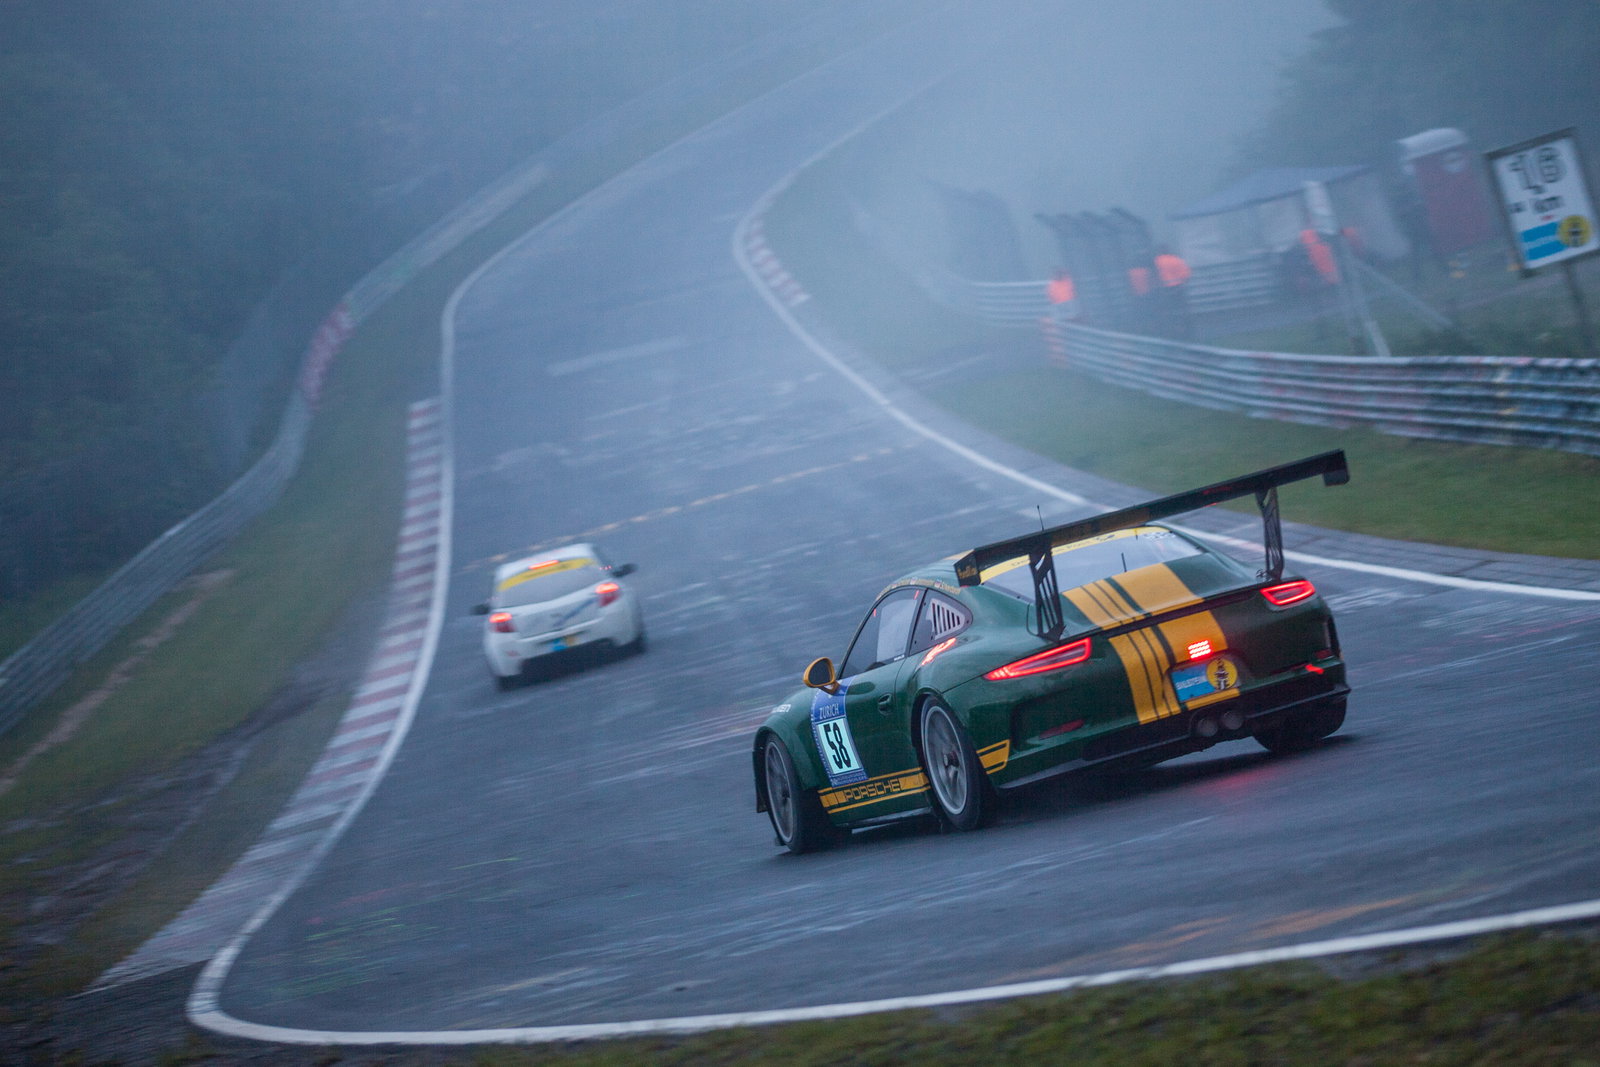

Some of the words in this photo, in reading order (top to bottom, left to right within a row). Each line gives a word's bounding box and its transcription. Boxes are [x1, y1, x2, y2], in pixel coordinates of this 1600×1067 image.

[819, 702, 839, 720] ZURICH
[823, 722, 852, 769] 58
[843, 778, 901, 801] PORSCHE
